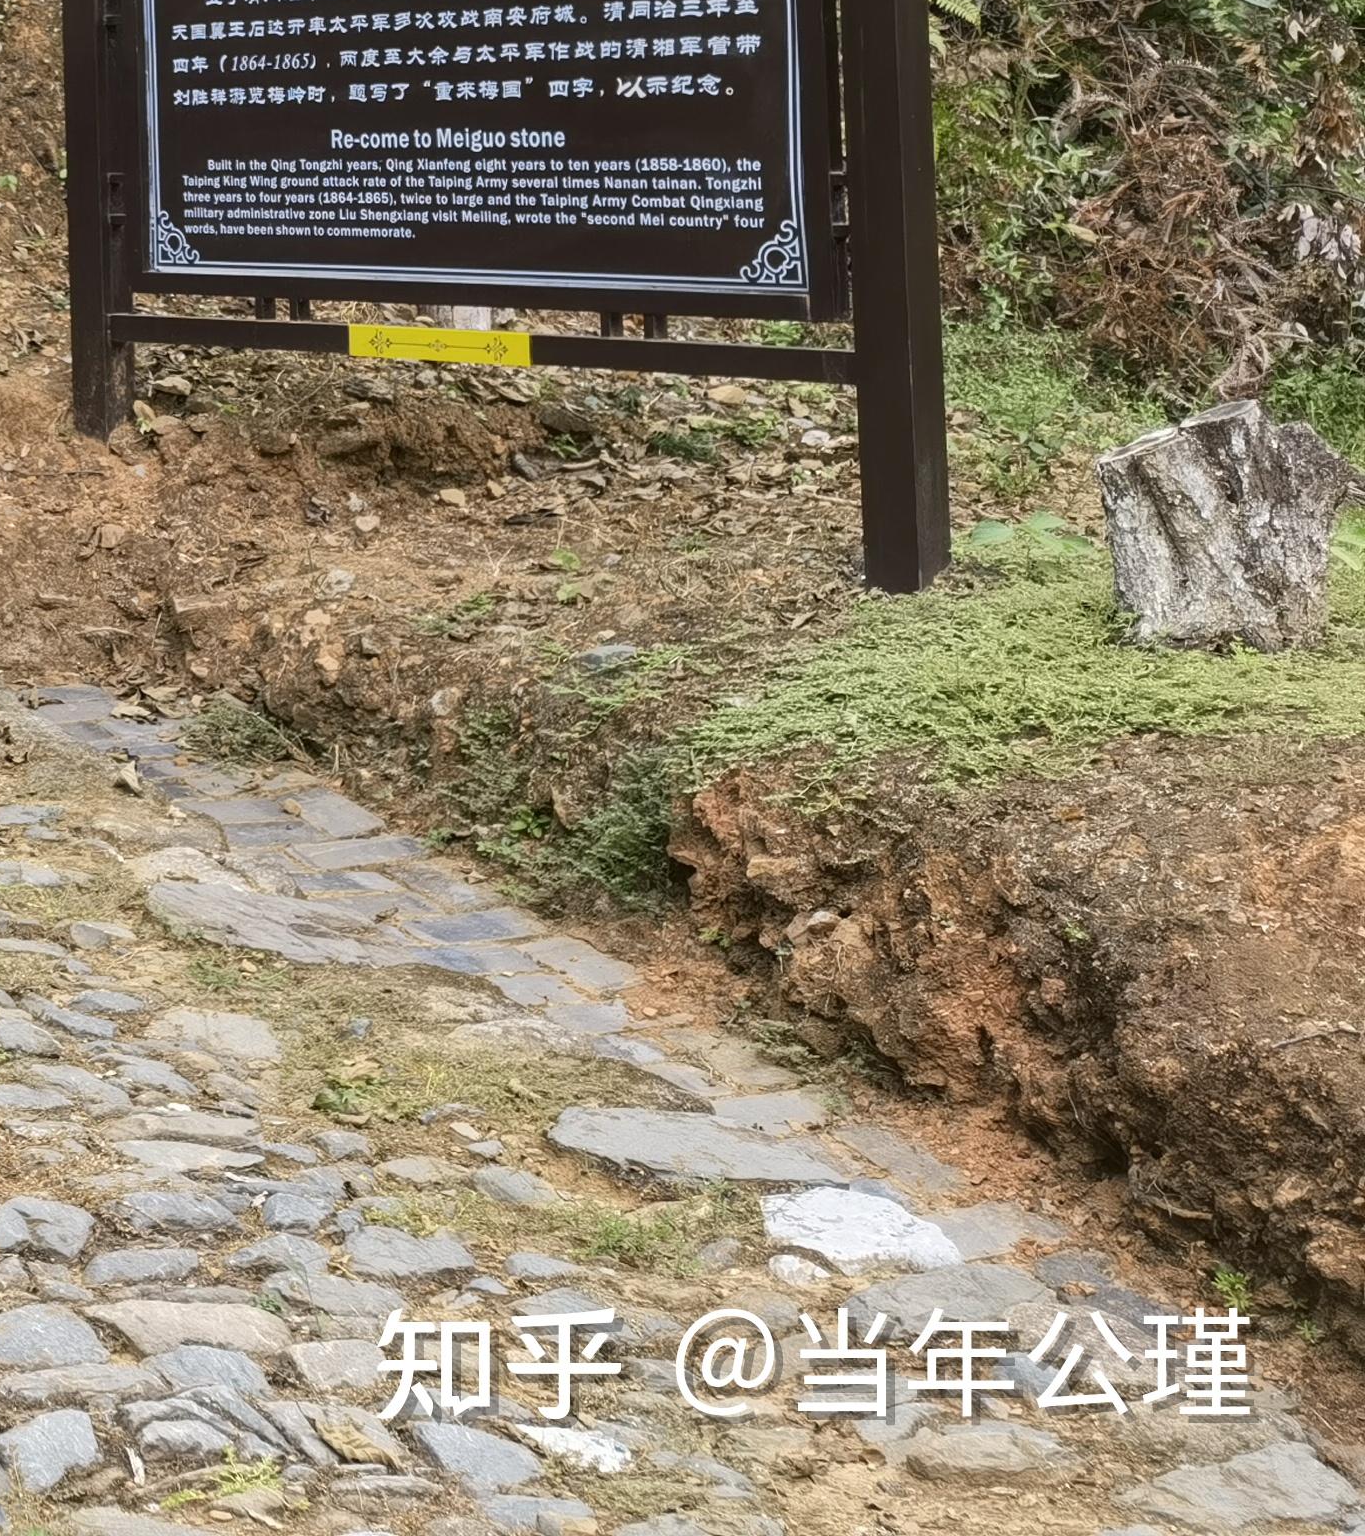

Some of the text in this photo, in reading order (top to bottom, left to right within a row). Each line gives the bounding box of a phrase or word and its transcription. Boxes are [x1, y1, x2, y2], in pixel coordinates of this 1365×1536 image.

[330, 128, 566, 152] Re-come to Meiguo stone
[206, 158, 762, 173] Built in the Qing Tongzhi years, Qing Xianfeng eight years to ten years (1858-1860), the
[181, 175, 762, 193] Taiping King Wing ground attack rate of the Taiping Army several times Nanan tainan. Tongzhi
[182, 191, 765, 212] three years to four years (1864-1865), twice to large and the Taiping Army Combat Qingxiang
[184, 207, 765, 230] military administrative zone Liu Shengxiang visit Meiling, wrote the "second Mei country" four
[183, 223, 416, 238] words, have been shown to commemorate.
